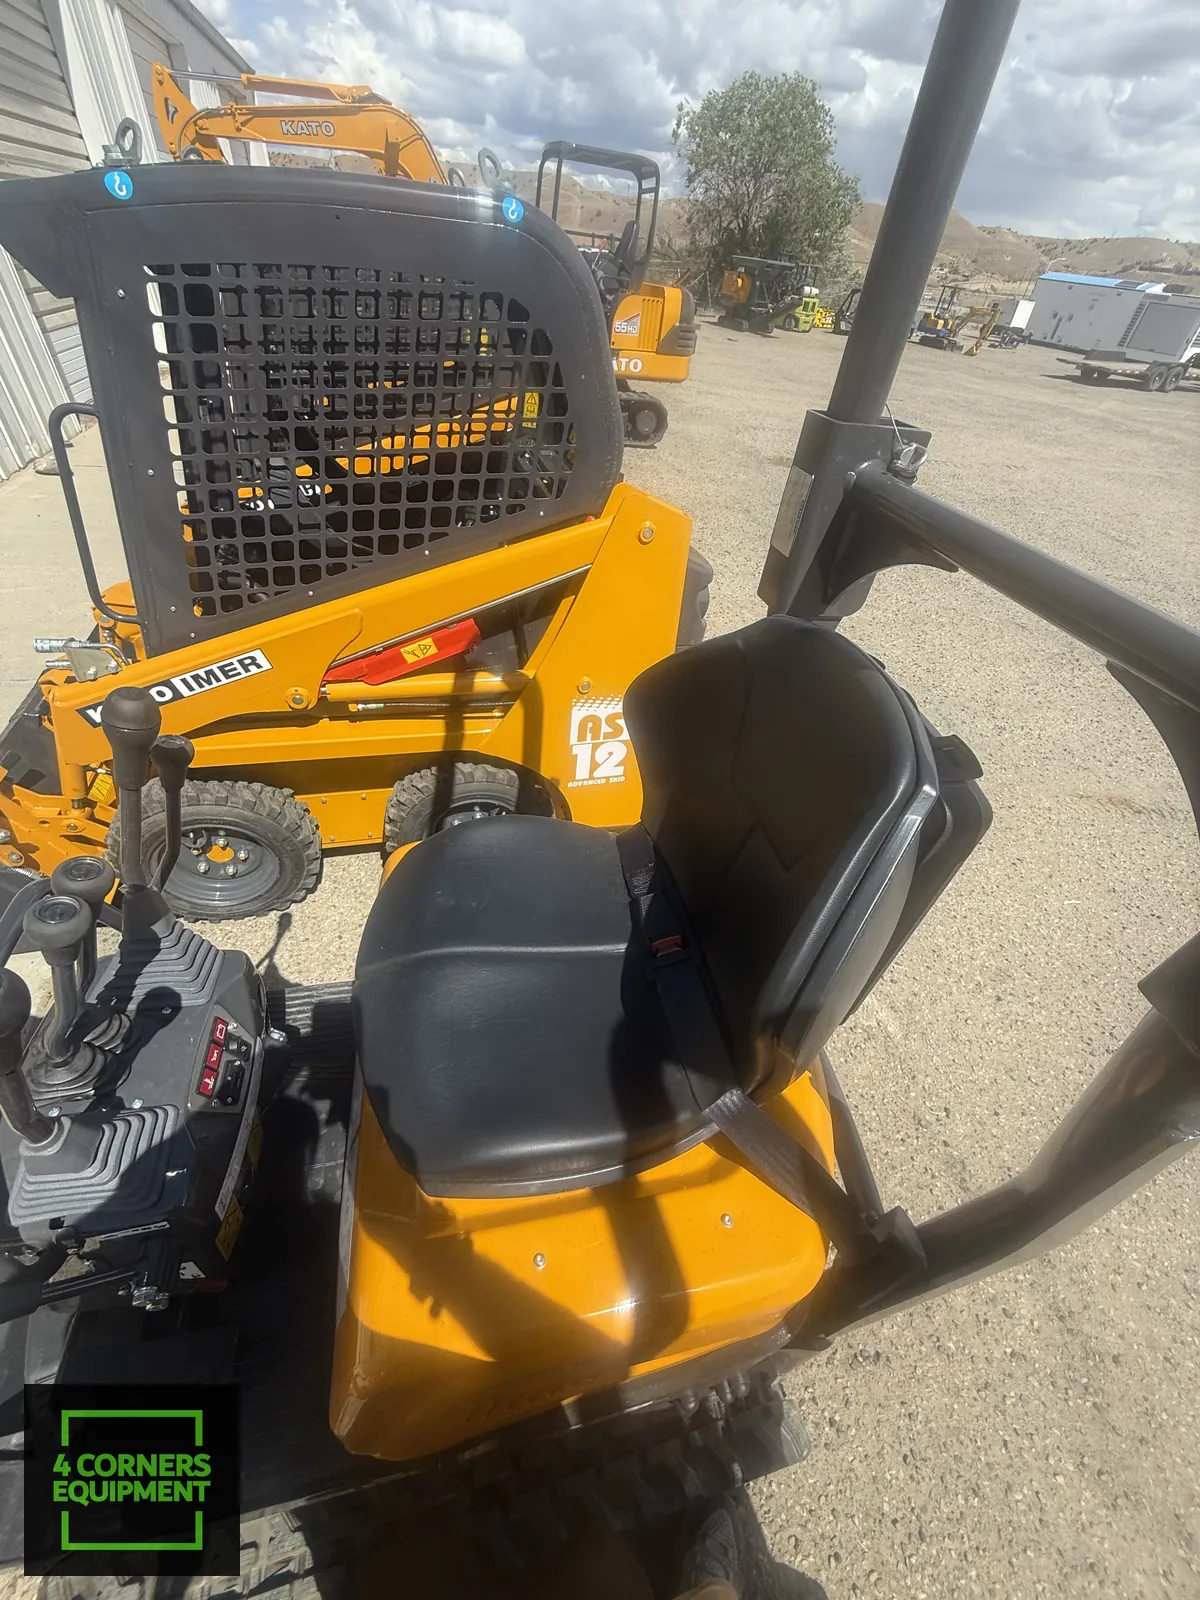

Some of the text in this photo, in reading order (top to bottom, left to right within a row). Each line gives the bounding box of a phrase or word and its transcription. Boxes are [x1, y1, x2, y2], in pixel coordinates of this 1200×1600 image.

[280, 120, 336, 136] KATO
[612, 357, 643, 373] ATO
[85, 655, 264, 723] KO IMER
[576, 712, 624, 742] AS
[572, 741, 627, 780] 12
